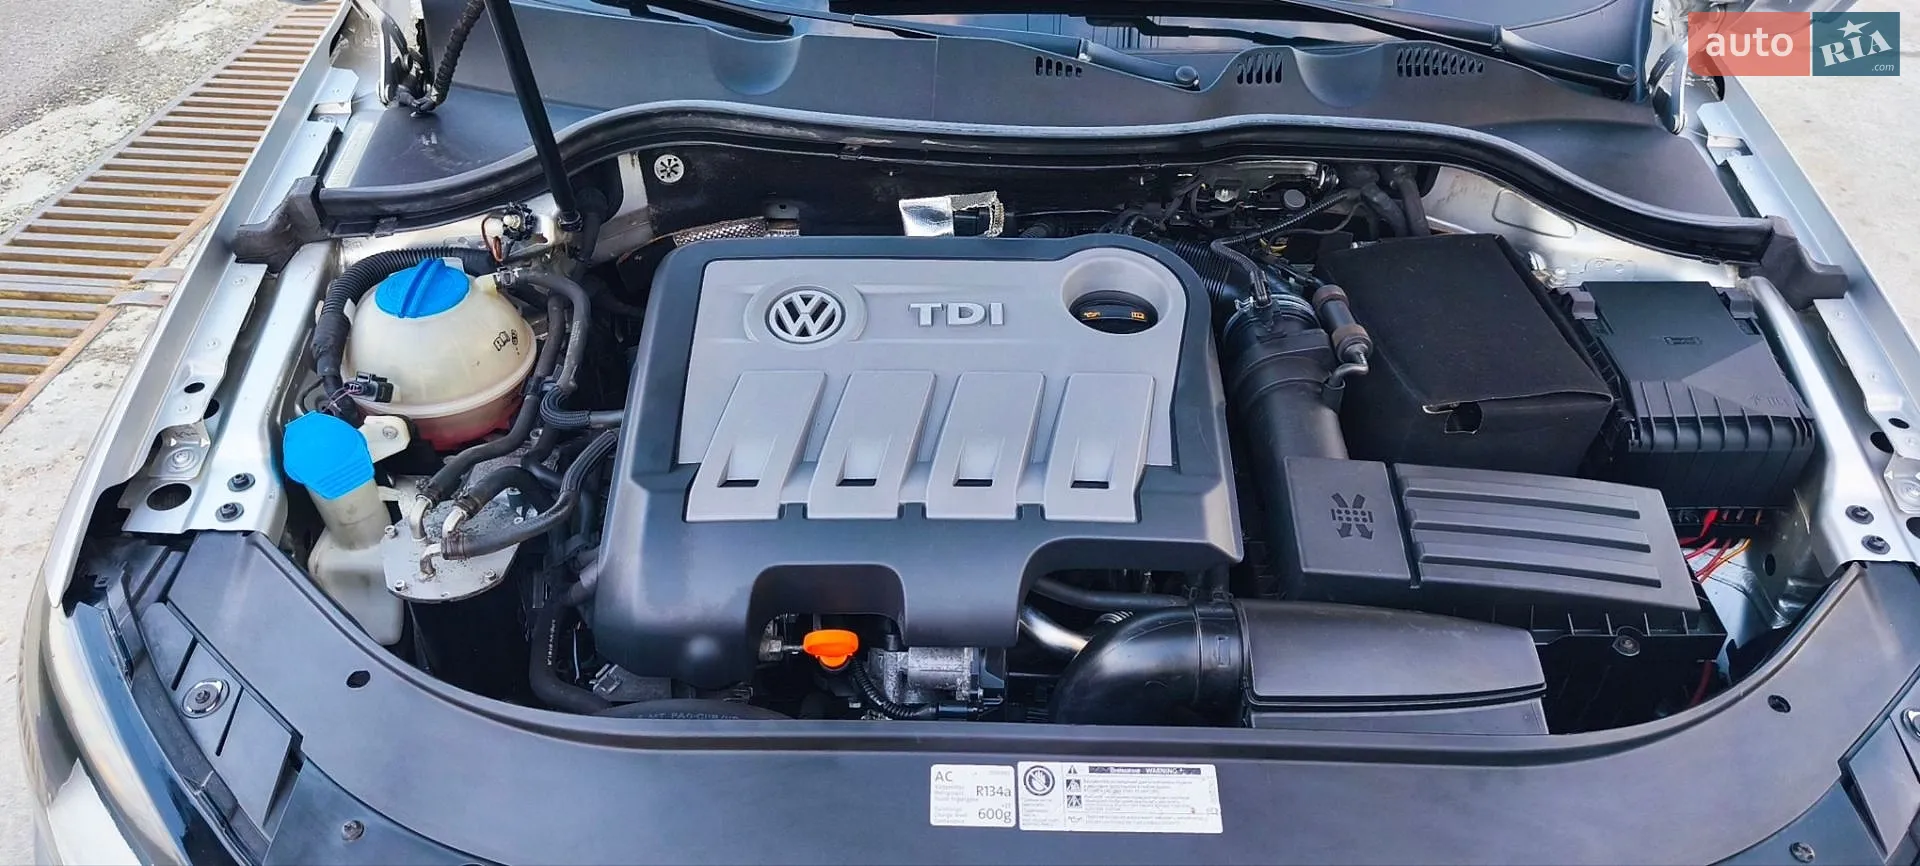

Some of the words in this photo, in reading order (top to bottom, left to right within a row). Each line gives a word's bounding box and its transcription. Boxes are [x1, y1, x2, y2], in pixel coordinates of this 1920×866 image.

[770, 291, 842, 342] VW
[909, 302, 1005, 327] TDI
[935, 771, 953, 782] AC
[976, 785, 1011, 798] R134a
[978, 808, 1012, 824] 600g
